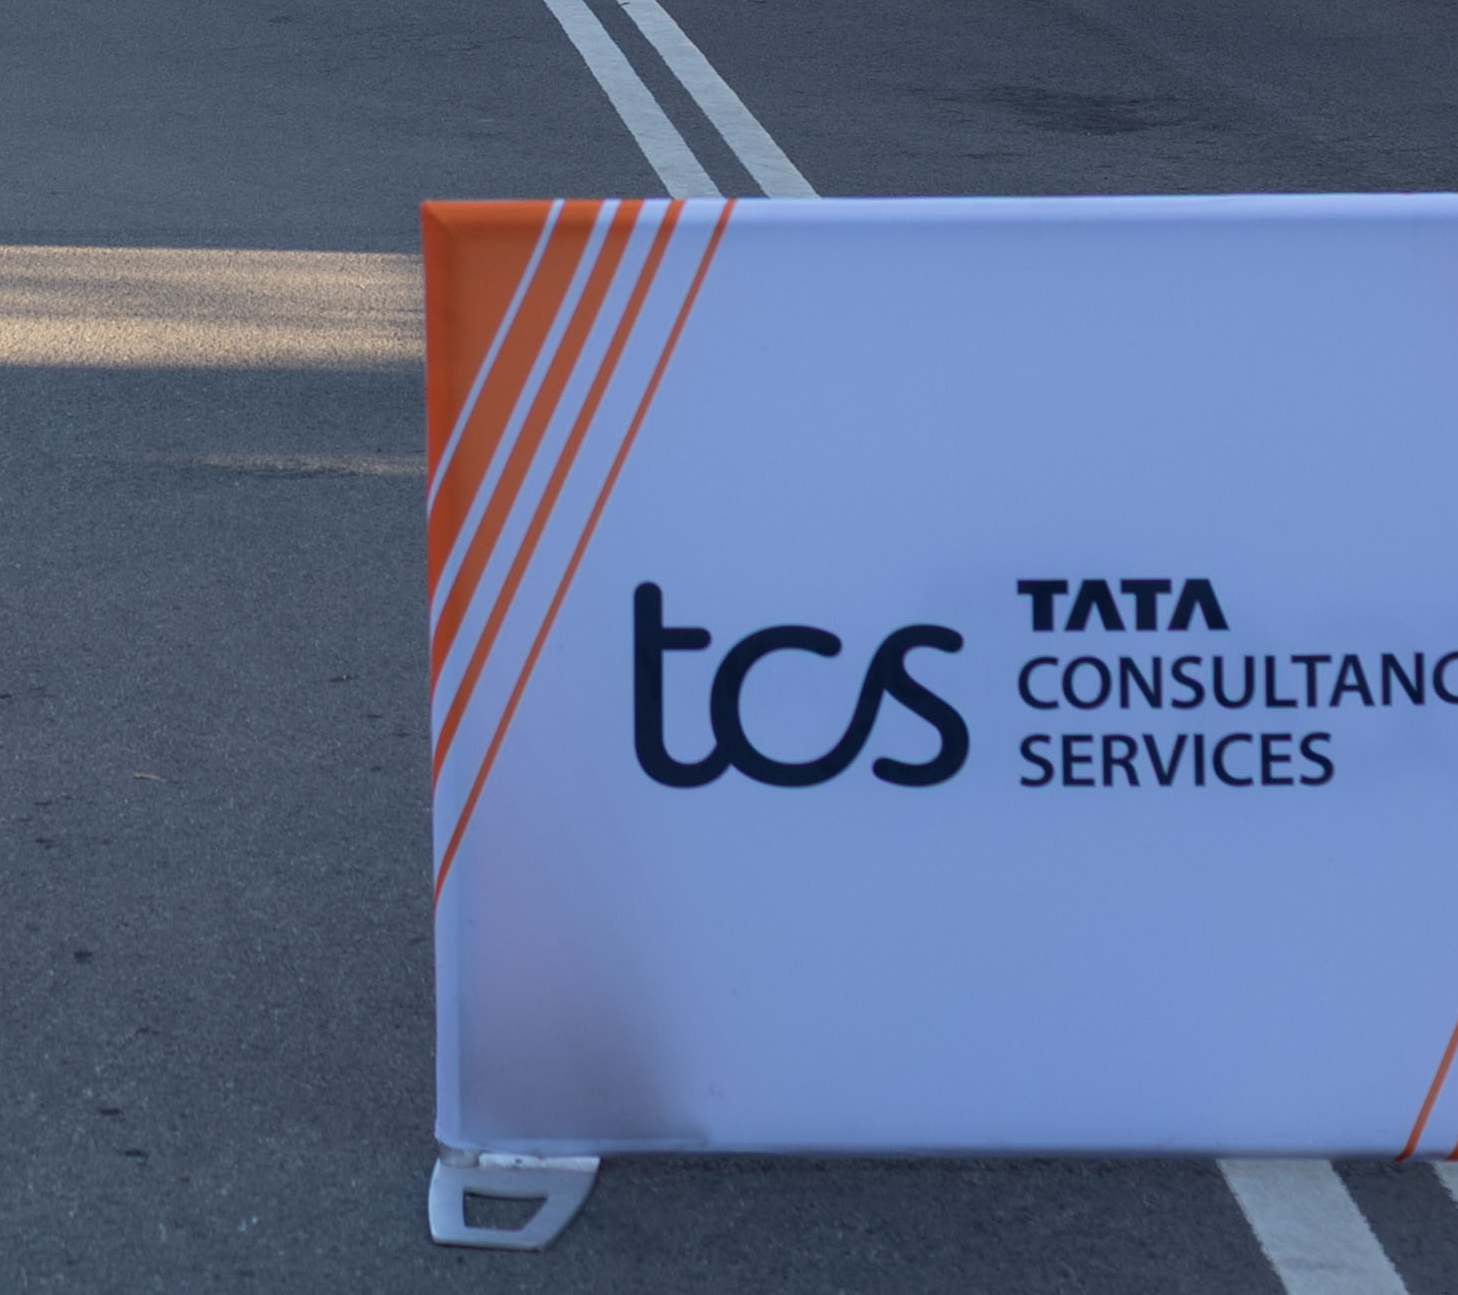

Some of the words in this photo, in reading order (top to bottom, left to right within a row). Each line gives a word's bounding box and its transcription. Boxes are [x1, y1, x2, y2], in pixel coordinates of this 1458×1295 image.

[1017, 578, 1230, 633] TATA
[631, 581, 971, 789] tcs
[1017, 731, 1336, 788] SERVICES
